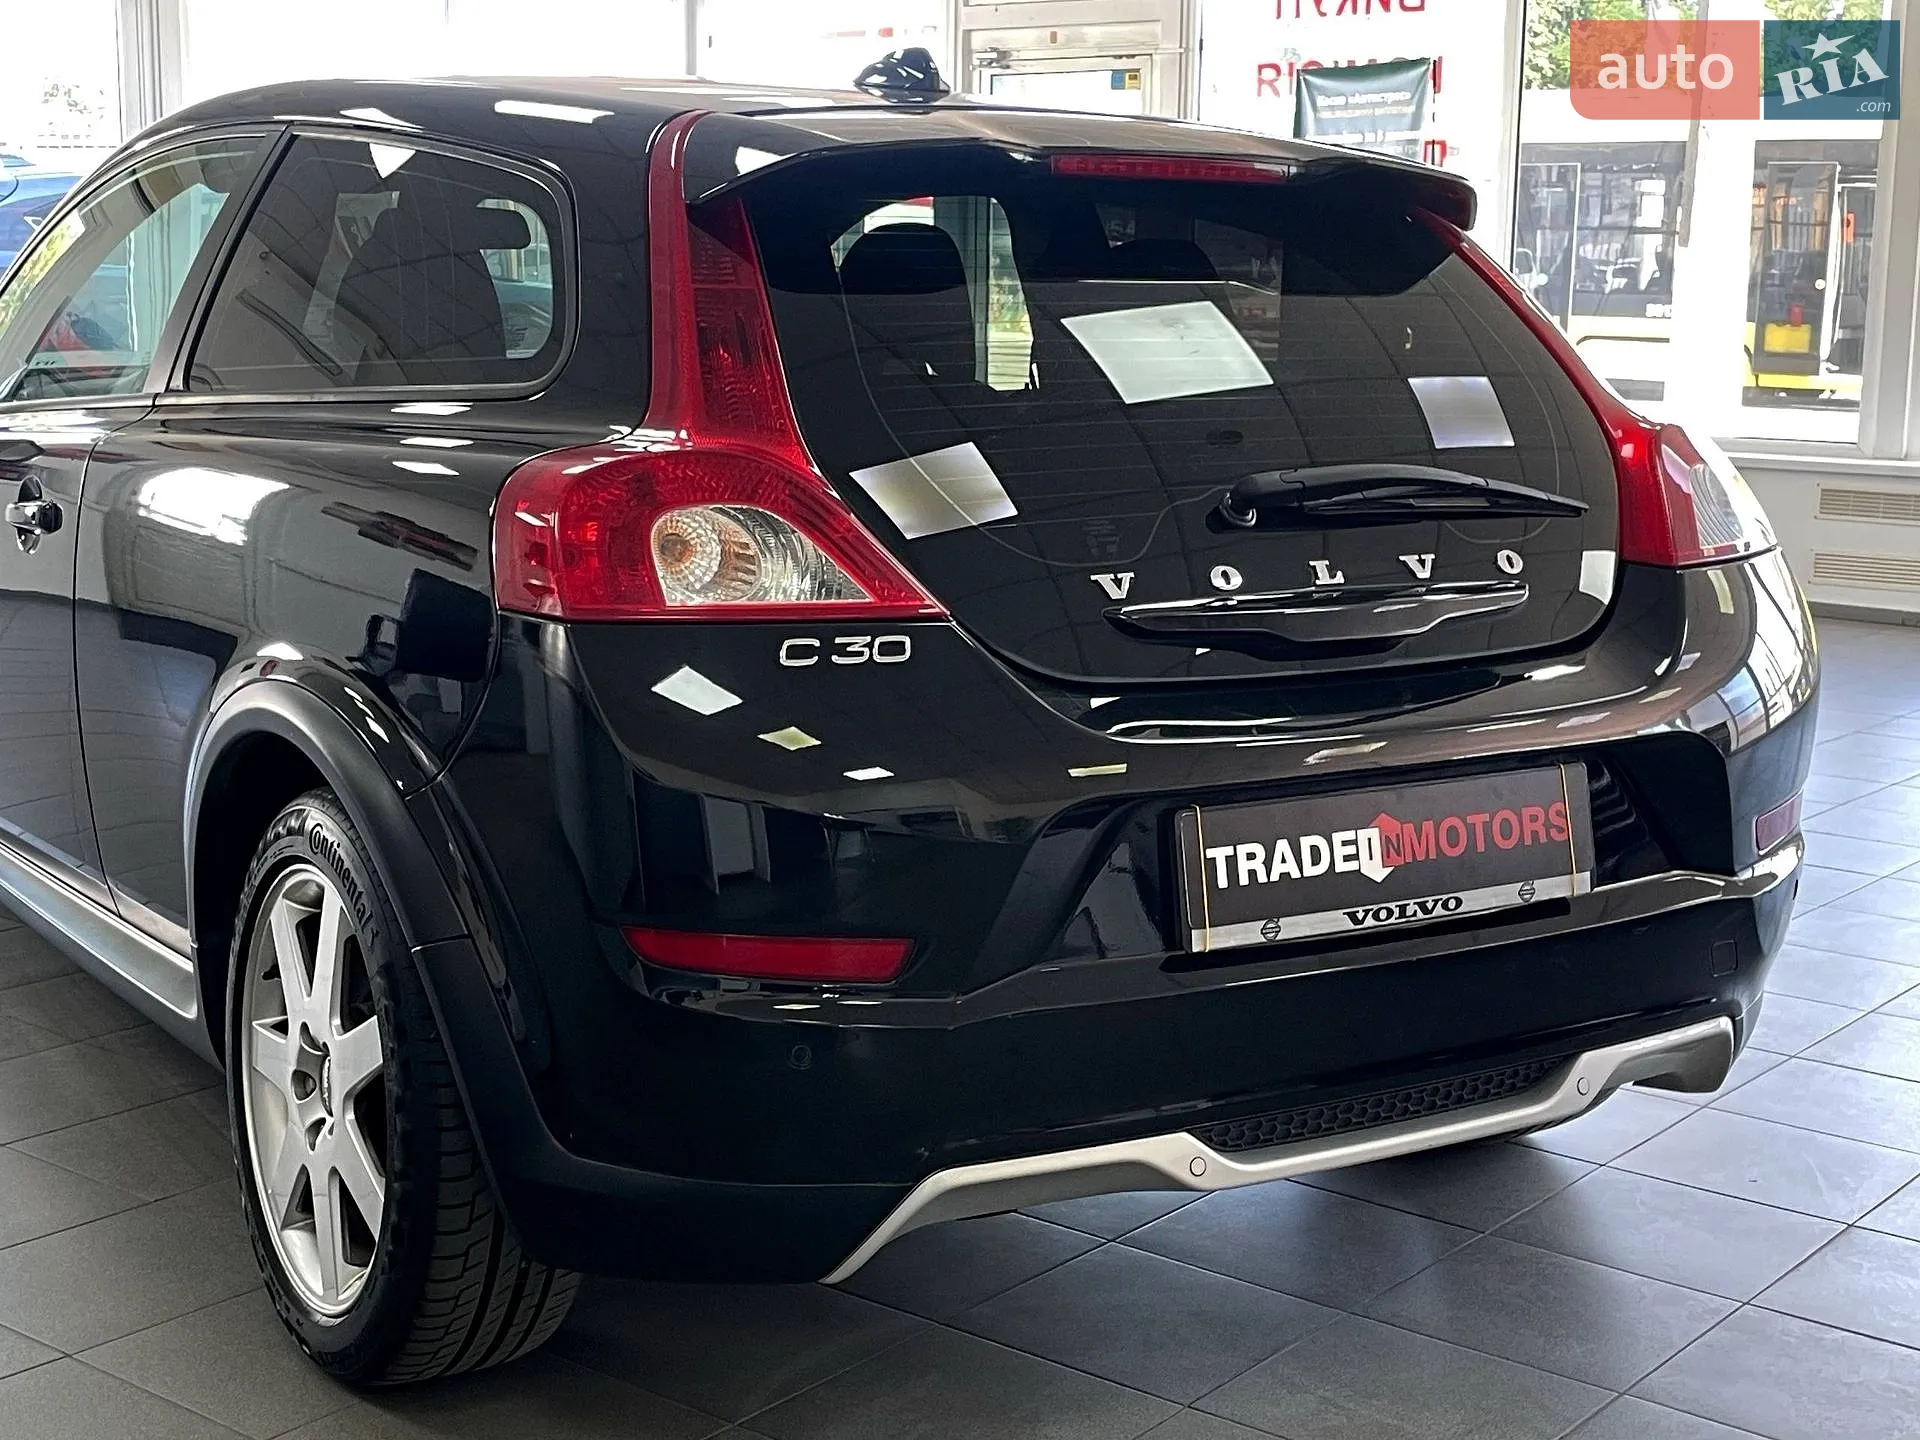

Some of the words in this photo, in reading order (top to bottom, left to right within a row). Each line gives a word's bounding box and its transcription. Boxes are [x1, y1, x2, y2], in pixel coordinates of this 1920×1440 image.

[1090, 549, 1524, 600] VOLVO
[308, 822, 374, 933] Continental
[1342, 896, 1464, 927] VOLVO
